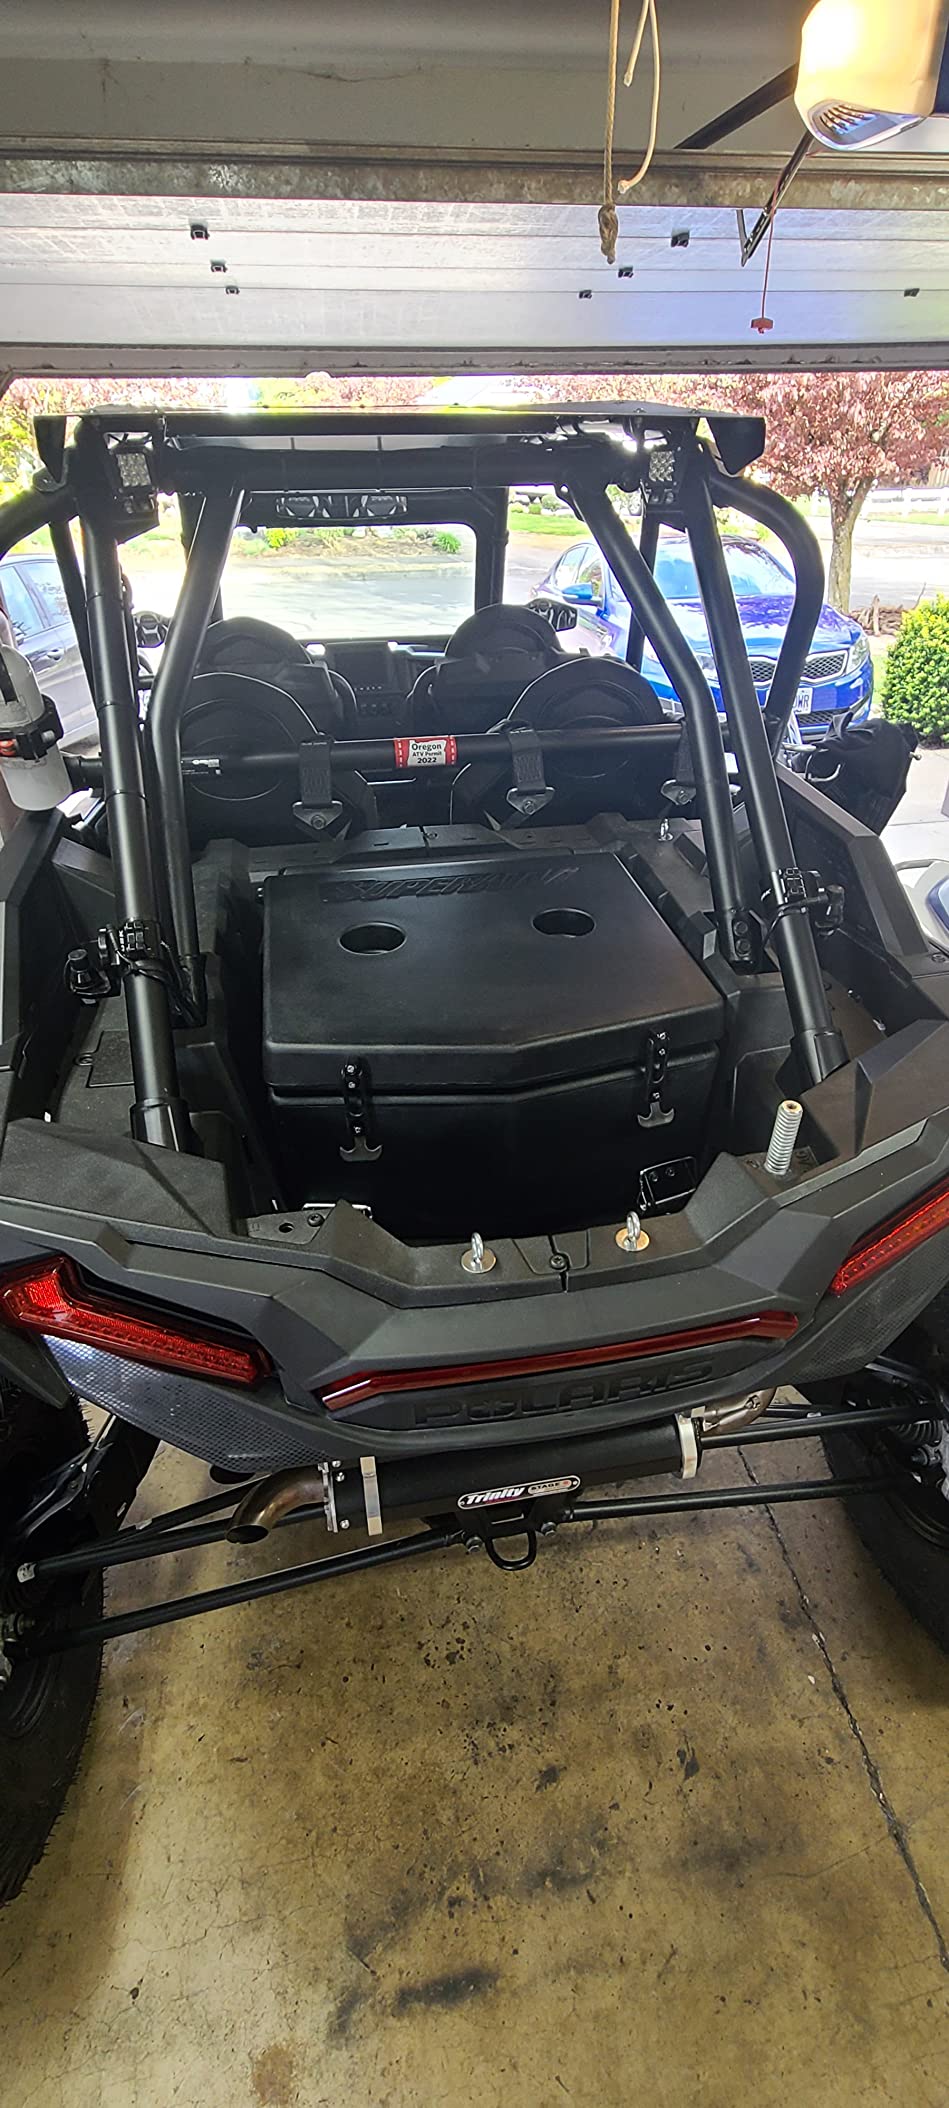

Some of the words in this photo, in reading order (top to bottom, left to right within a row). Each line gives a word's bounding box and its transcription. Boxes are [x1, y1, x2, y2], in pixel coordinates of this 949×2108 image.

[411, 743, 442, 751] Oregon
[409, 1361, 713, 1425] POLARIS
[466, 1487, 526, 1505] Trinity
[531, 1482, 560, 1491] STAGE
